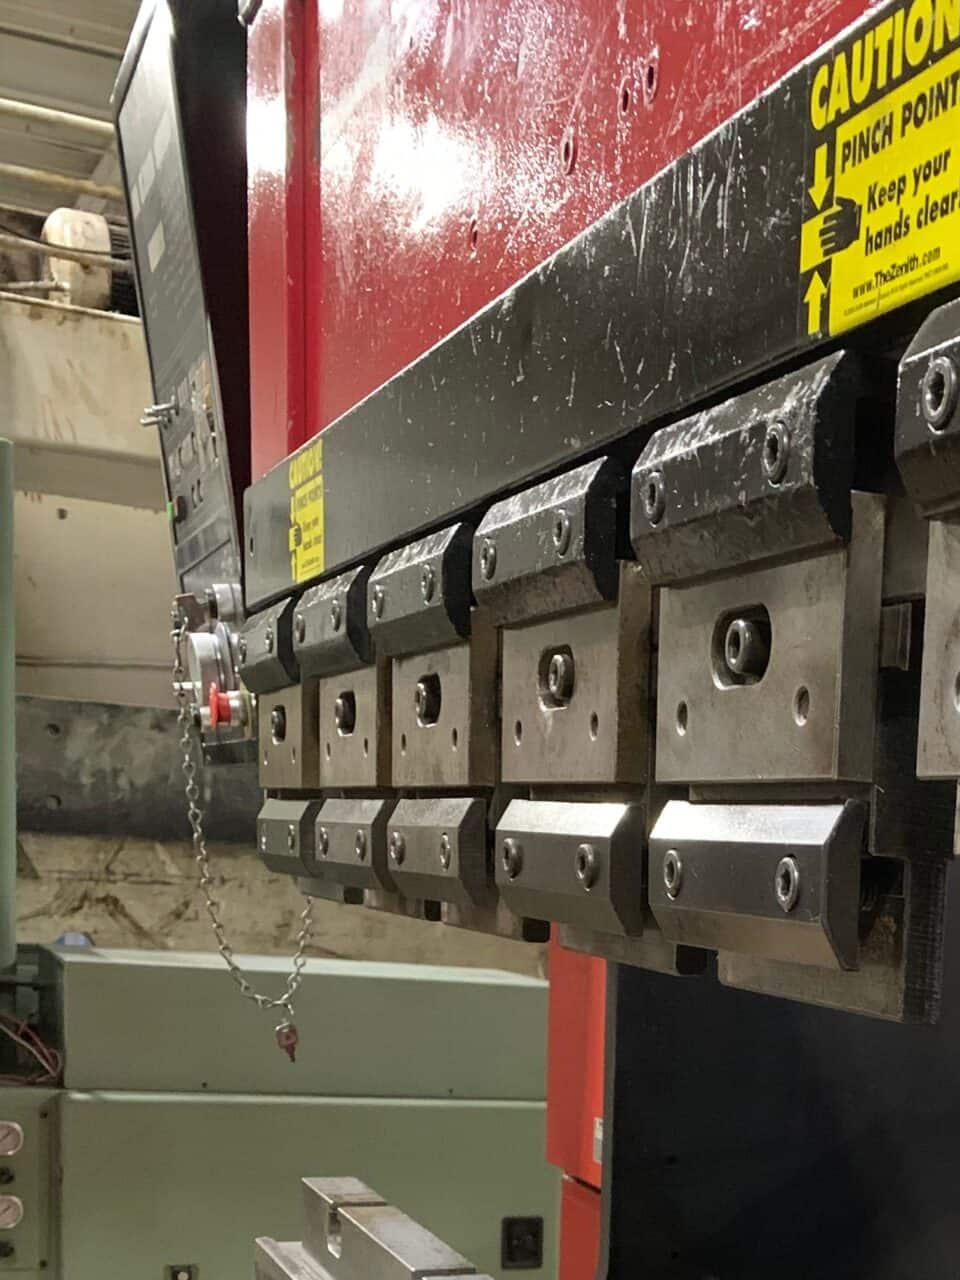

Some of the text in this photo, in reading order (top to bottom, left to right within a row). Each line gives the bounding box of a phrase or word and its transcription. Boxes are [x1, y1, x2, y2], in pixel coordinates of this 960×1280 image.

[840, 111, 893, 174] PINCH
[866, 148, 951, 214] Keep your
[865, 209, 910, 257] hands
